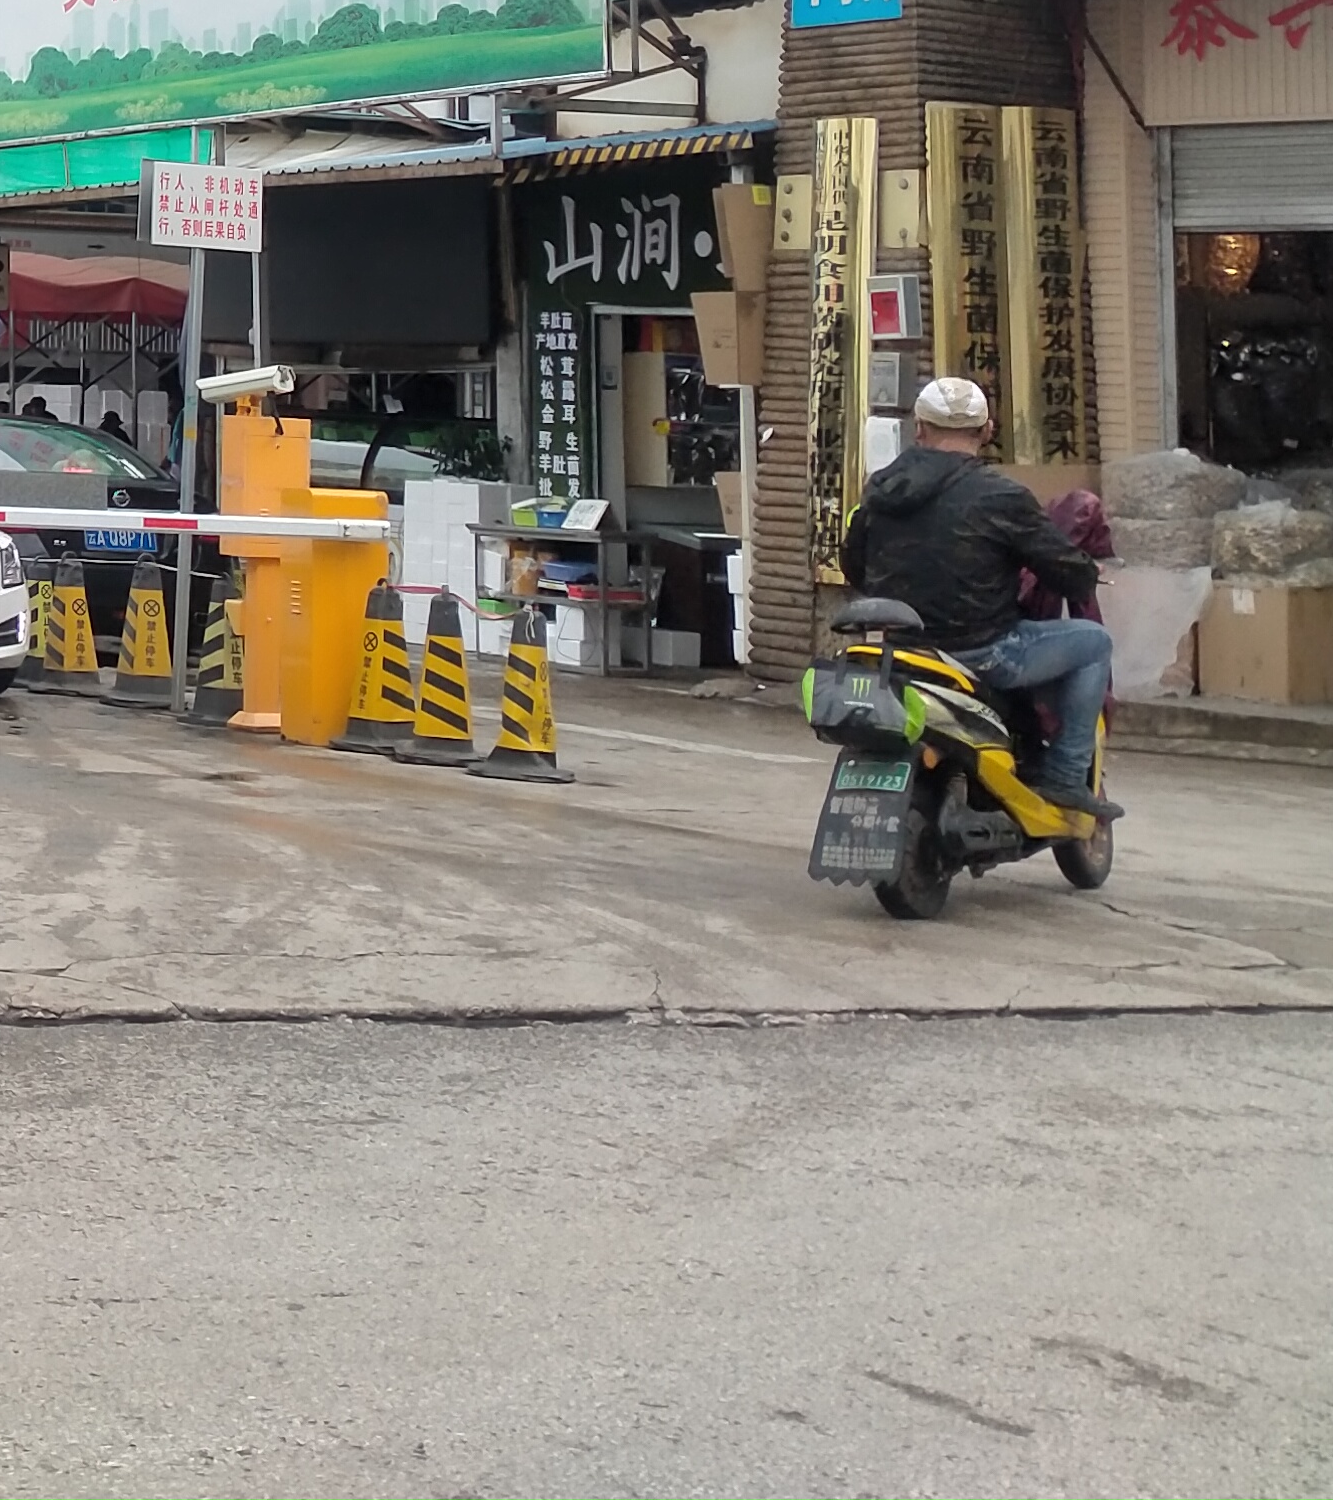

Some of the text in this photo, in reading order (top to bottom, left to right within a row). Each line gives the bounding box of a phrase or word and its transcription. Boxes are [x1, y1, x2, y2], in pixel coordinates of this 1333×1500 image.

[159, 194, 259, 220] 禁止从闸杆处通
[539, 311, 573, 330] 羊肚菌
[535, 332, 579, 351] 产地直发
[539, 355, 575, 377] 松茸
[540, 379, 576, 402] 松露
[541, 403, 576, 425] 金耳
[538, 430, 580, 452] 野生
[538, 454, 580, 476] 羊肚菌
[538, 477, 581, 499] 批发
[75, 619, 86, 667] 禁止停车
[145, 620, 157, 668] 禁止停车
[357, 656, 374, 711] 禁止停车
